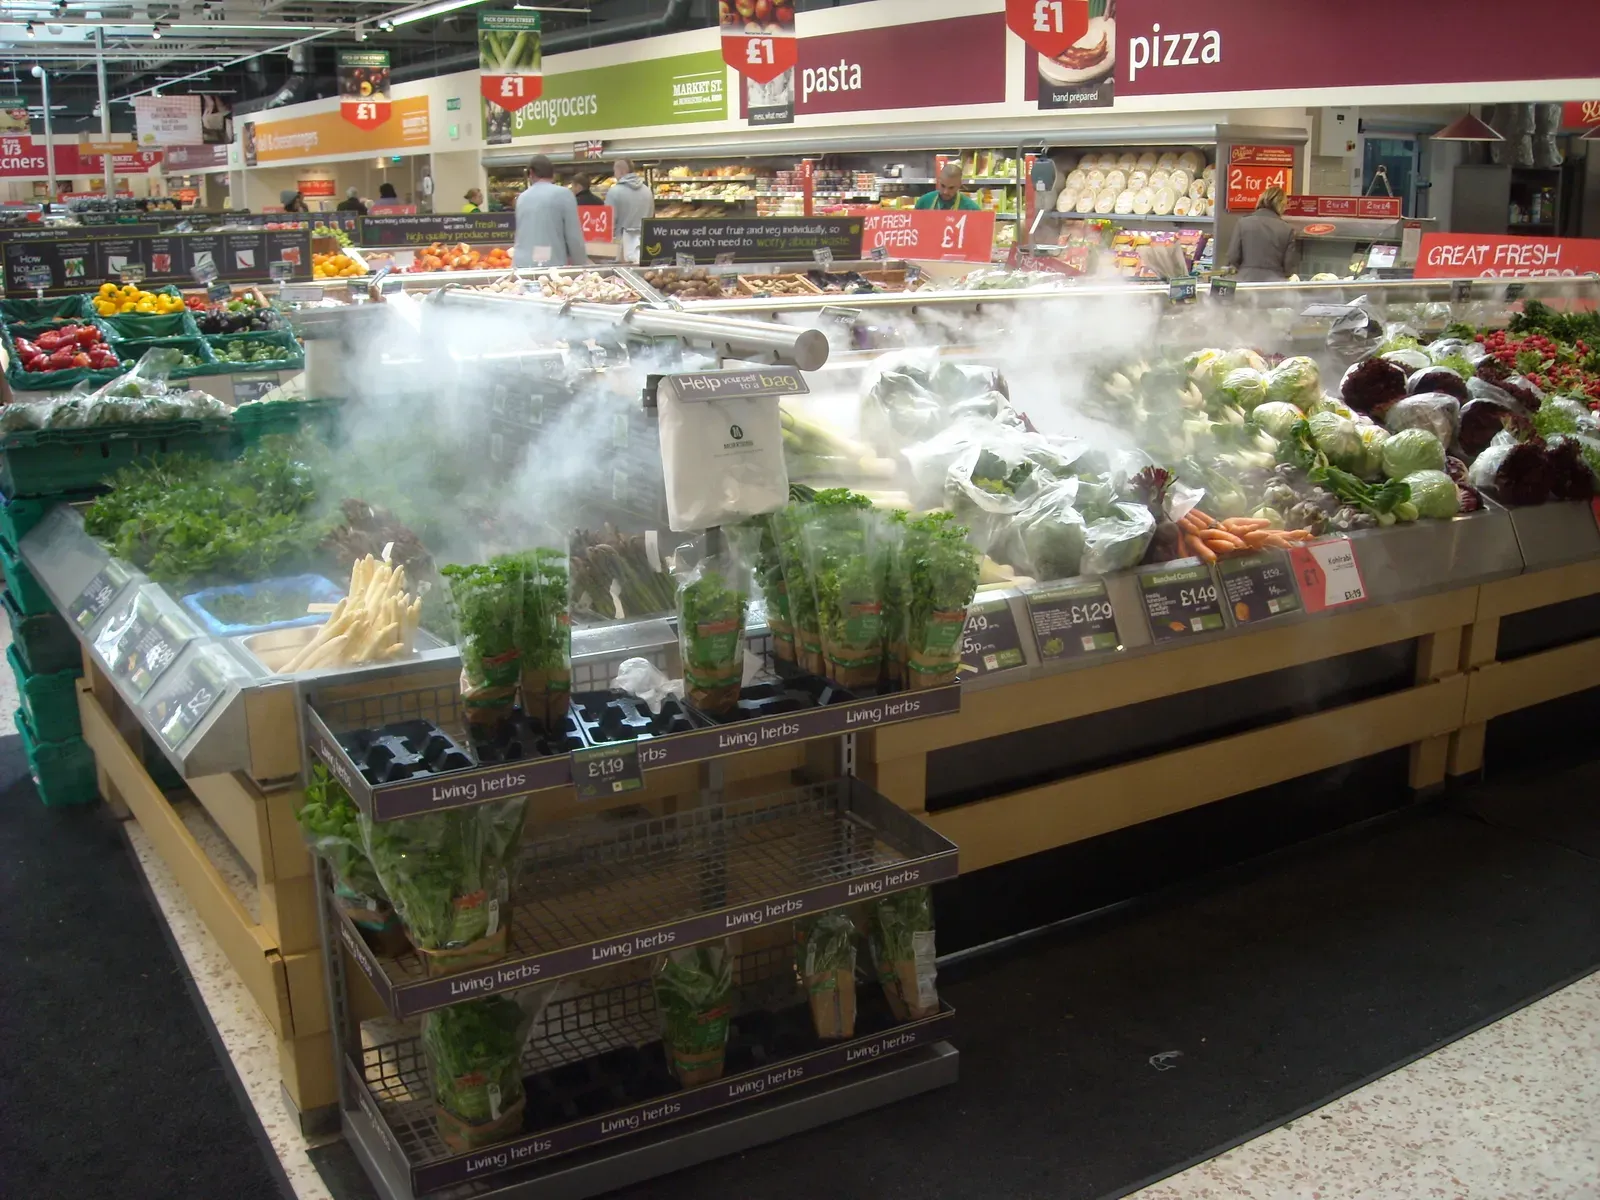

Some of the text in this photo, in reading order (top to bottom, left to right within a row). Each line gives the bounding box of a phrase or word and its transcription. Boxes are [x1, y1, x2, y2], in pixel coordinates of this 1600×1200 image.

[1033, 0, 1063, 33] £1
[746, 38, 774, 64] £1
[1129, 23, 1221, 81] pizza
[501, 77, 524, 97] £1
[673, 79, 722, 96] MARKET ST.
[802, 59, 862, 102] pasta
[1052, 90, 1098, 103] hand prepared
[357, 103, 377, 120] £1
[515, 94, 598, 129] greengrocers
[2, 144, 21, 155] 1/3
[1230, 169, 1285, 190] 2 for £4
[1340, 200, 1349, 208] £4
[1367, 201, 1372, 209] 2
[1382, 201, 1391, 209] £4
[475, 220, 496, 229] fresh
[582, 211, 591, 232] 2
[595, 212, 607, 233] £3
[653, 225, 840, 236] We now sell our fruit and veg individually, so
[864, 214, 912, 231] EAT FRESH
[941, 214, 967, 248] £1
[406, 232, 424, 241] high
[426, 230, 454, 241] quality
[455, 230, 489, 240] produce
[673, 236, 849, 249] you don't need to worry about waste
[874, 229, 919, 247] OFFERS
[20, 255, 42, 263] How
[1428, 243, 1562, 266] GREAT FRESH
[13, 264, 29, 272] hot
[13, 275, 28, 284] yo
[679, 375, 721, 391] Help
[722, 374, 757, 384] yourself
[759, 373, 798, 390] bag
[1328, 554, 1352, 565] Kohlrabi
[1152, 571, 1197, 584] Bunched Carrots
[1180, 585, 1217, 606] £1.49
[1071, 602, 1113, 624] £1.29
[961, 638, 982, 655] 5p
[846, 701, 921, 725] Living herbs
[719, 722, 800, 747] Living herbs
[588, 757, 624, 777] £1.19
[432, 773, 526, 801] Living herbs
[848, 869, 919, 896] Living herbs
[726, 899, 803, 927] Living herbs
[592, 931, 676, 960] Living herbs
[451, 964, 541, 995] Living herbs
[847, 1032, 915, 1061] Living herbs
[729, 1066, 803, 1097] Living herbs
[601, 1102, 681, 1133] Living herbs
[466, 1139, 551, 1172] Living herbs
